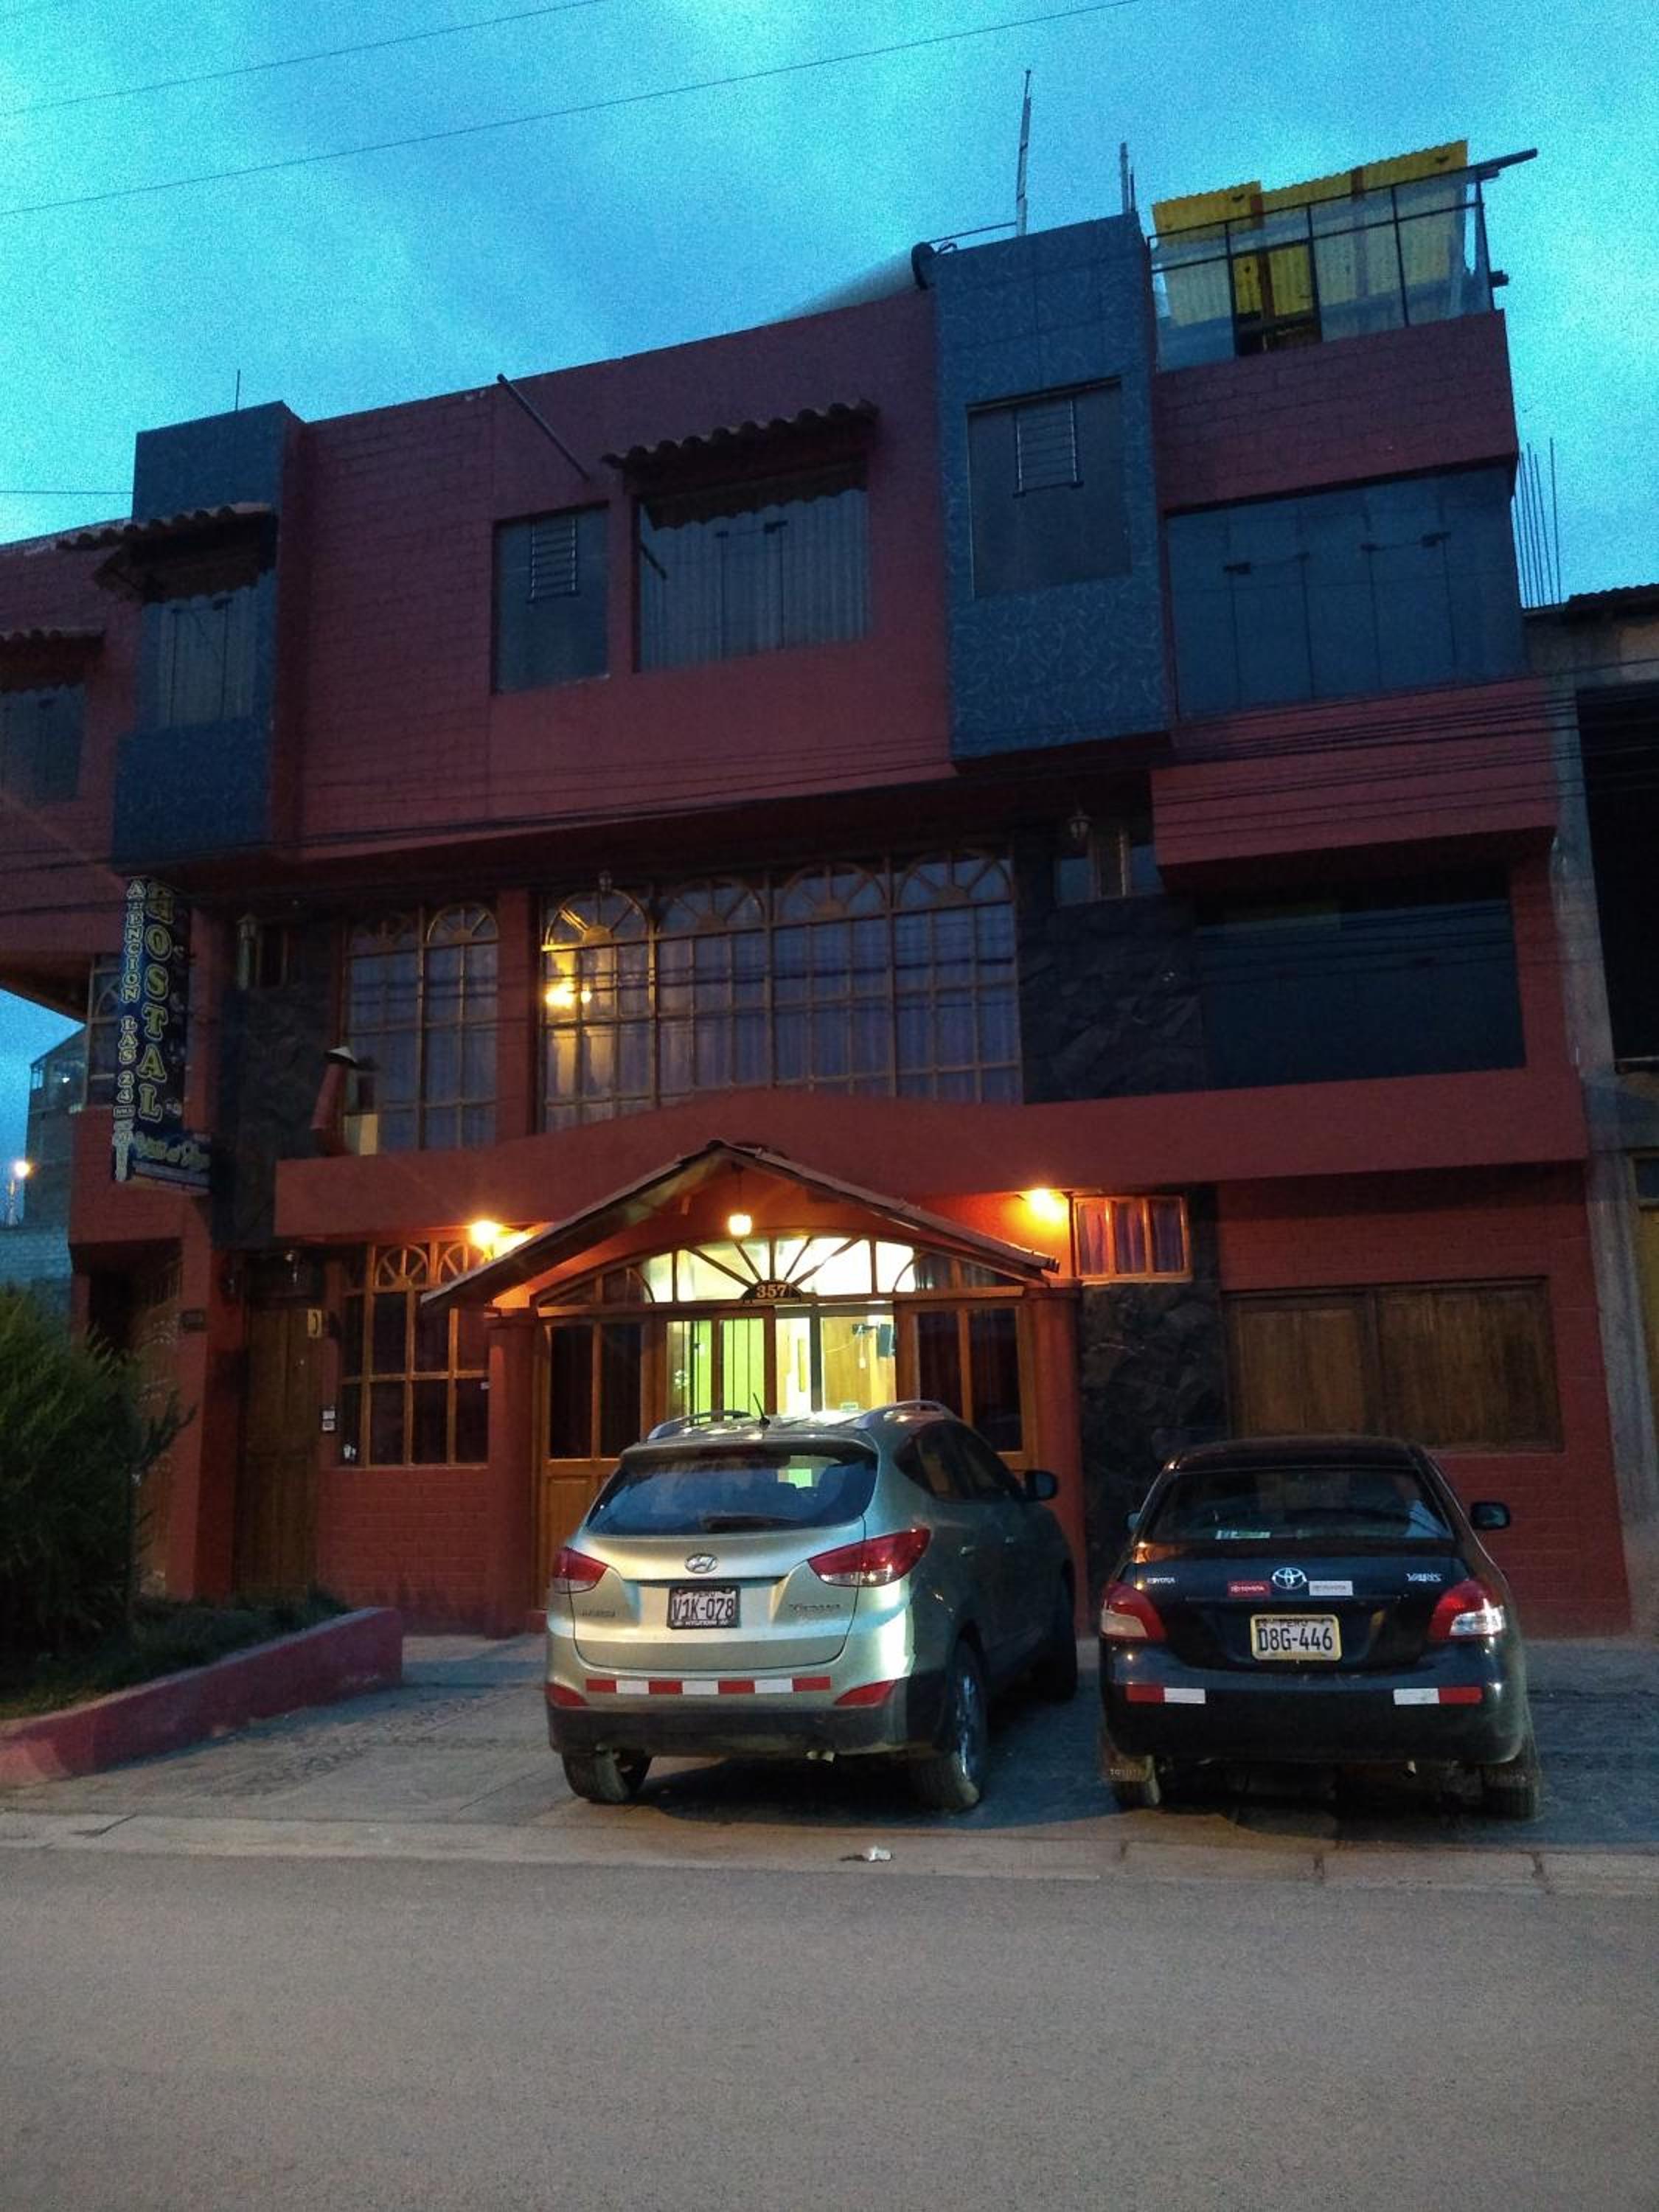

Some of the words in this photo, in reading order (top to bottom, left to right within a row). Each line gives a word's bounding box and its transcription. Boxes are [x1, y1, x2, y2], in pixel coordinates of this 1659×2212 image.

[137, 880, 175, 1122] HOSTAL
[118, 1015, 139, 1065] LAS
[757, 1284, 787, 1298] 357
[1406, 1572, 1442, 1582] YARIS
[672, 1598, 734, 1621] V1K-078
[1258, 1627, 1333, 1651] D8G-446
